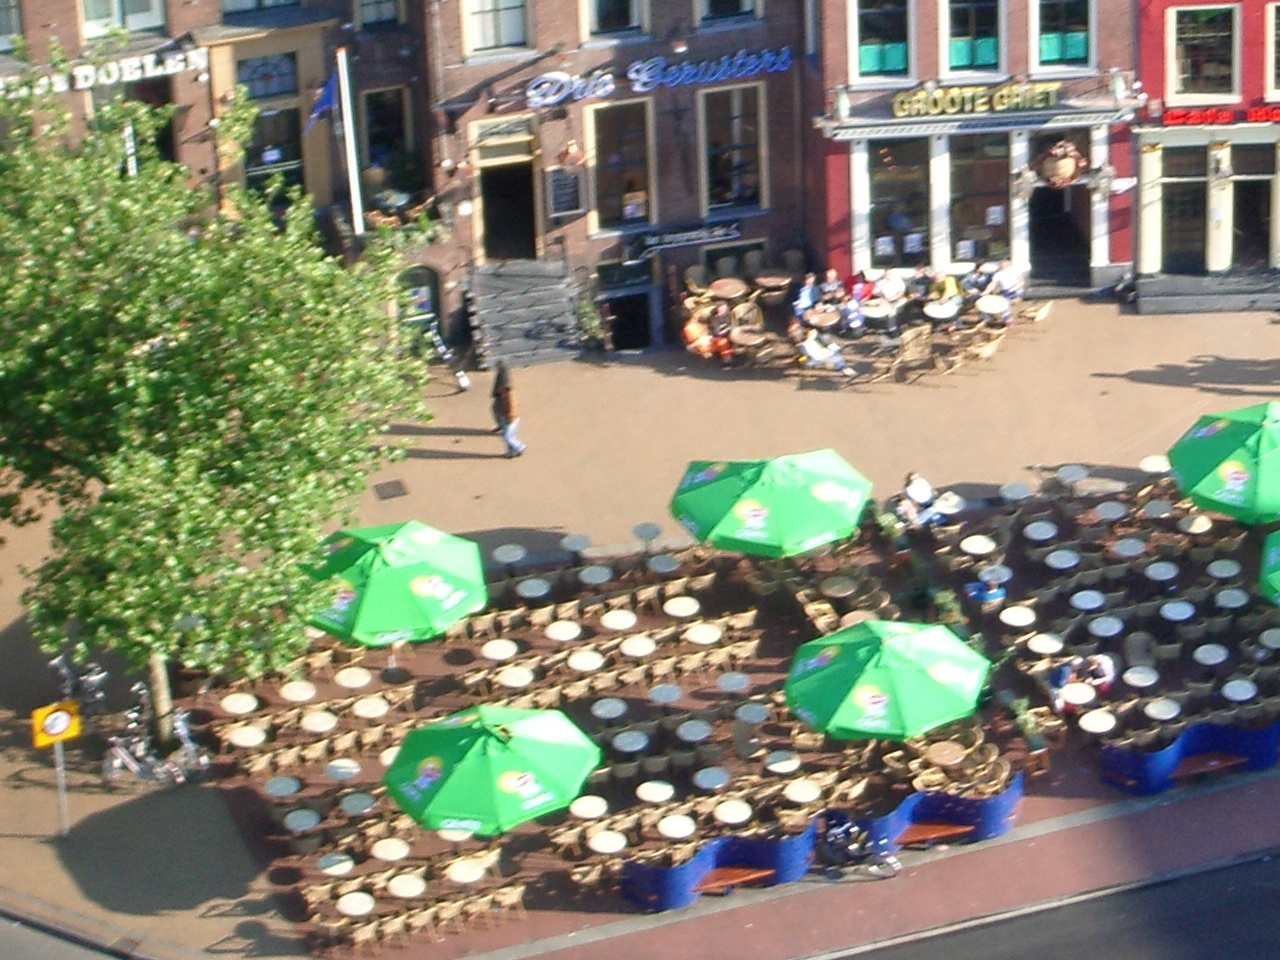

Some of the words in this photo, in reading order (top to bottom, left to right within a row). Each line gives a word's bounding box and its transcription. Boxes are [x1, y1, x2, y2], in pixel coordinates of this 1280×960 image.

[72, 46, 210, 90] DOELEN
[892, 86, 992, 118] GROOTE
[991, 81, 1063, 111] GRIET
